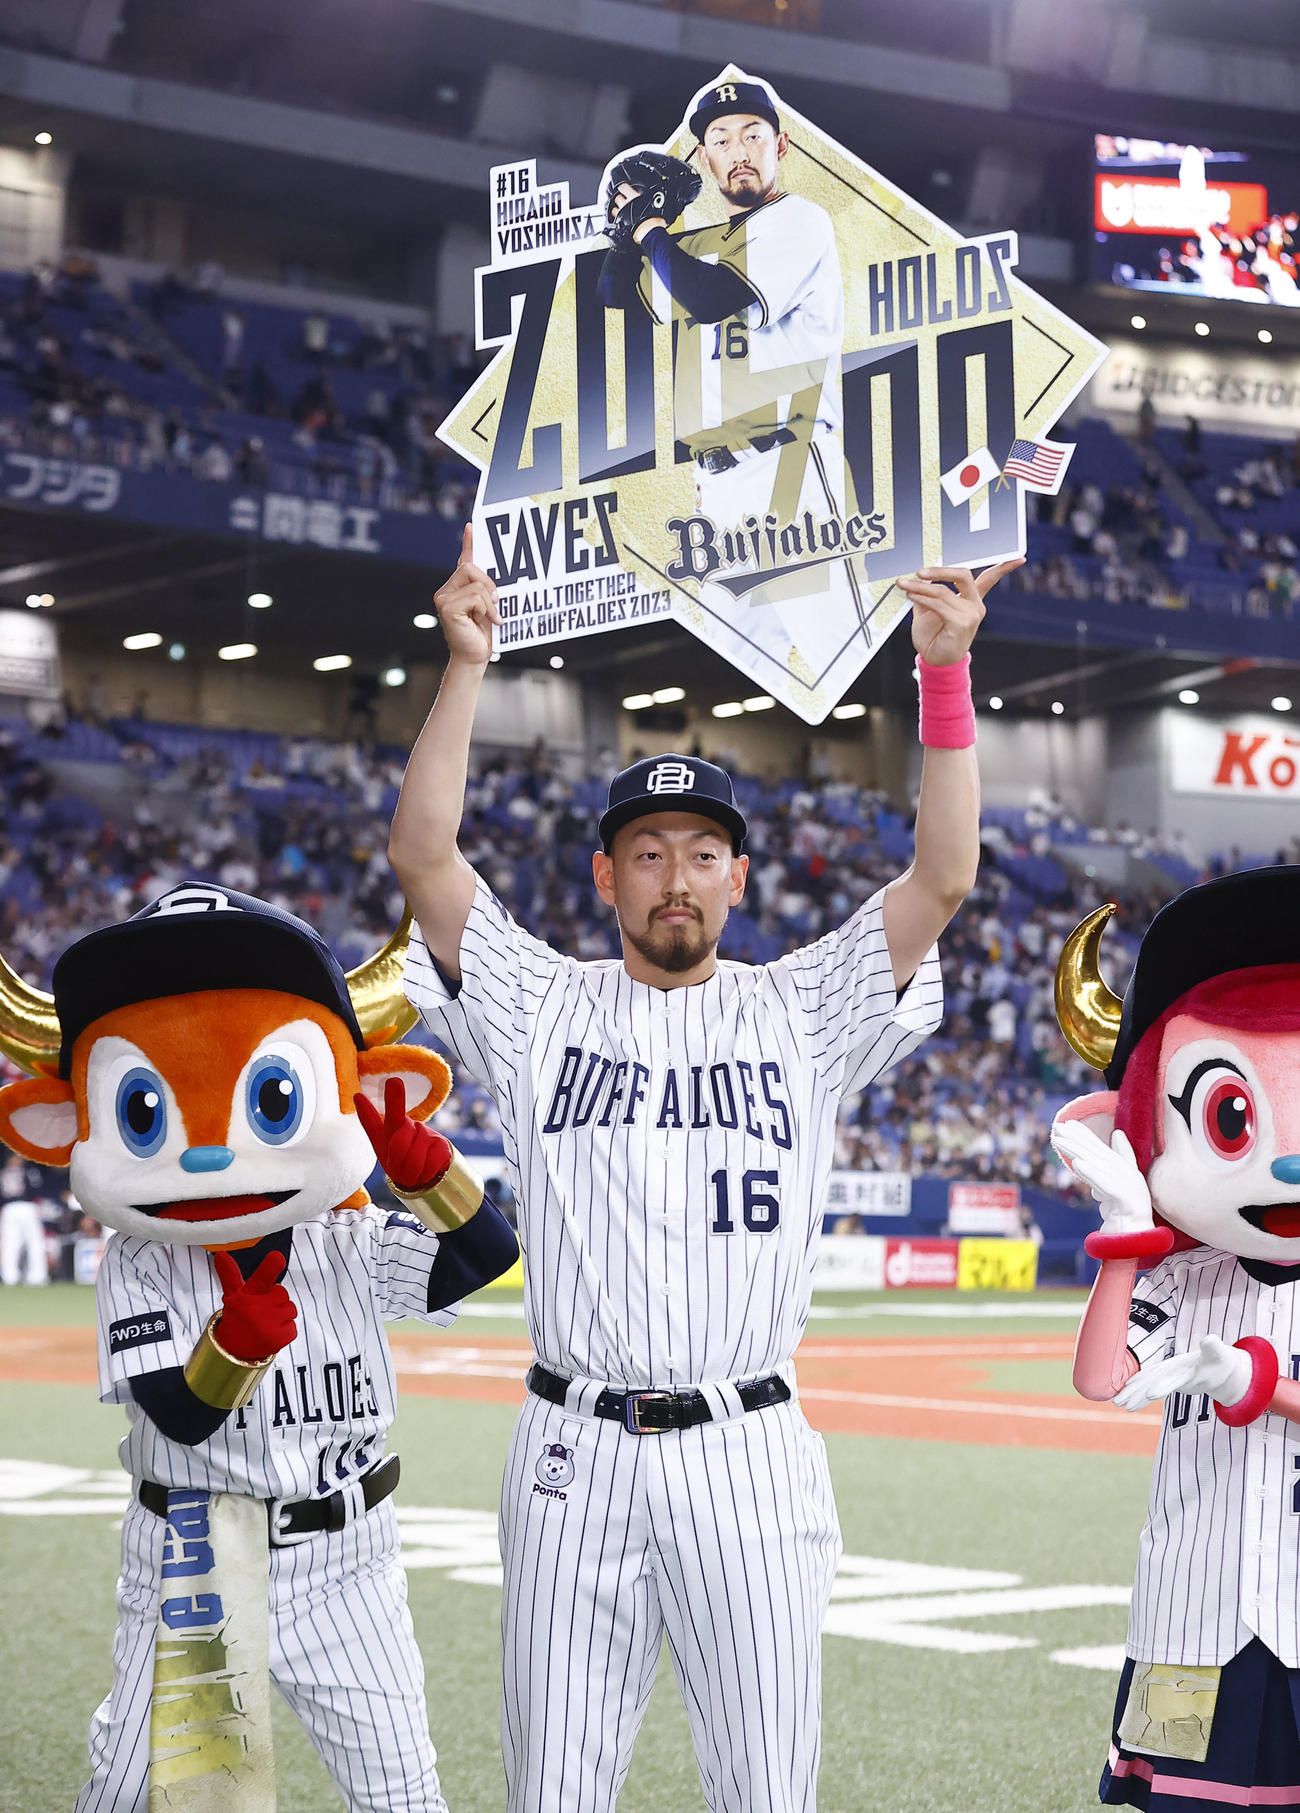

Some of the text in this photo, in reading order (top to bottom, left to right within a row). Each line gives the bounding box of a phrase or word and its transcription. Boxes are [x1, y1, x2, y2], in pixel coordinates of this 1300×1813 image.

[497, 168, 529, 198] #16
[497, 213, 596, 255] YOSHIHISA
[869, 238, 1013, 336] HOLDS
[711, 320, 748, 360] 16
[485, 491, 620, 587] SAVES
[500, 595, 518, 618] GO
[537, 599, 627, 638] BUFFALOES
[630, 589, 672, 618] 2023
[543, 1046, 792, 1151] BUFFALOES
[711, 1168, 780, 1233] 16
[110, 1319, 167, 1344] FWD生命
[532, 1483, 568, 1501] Ponta
